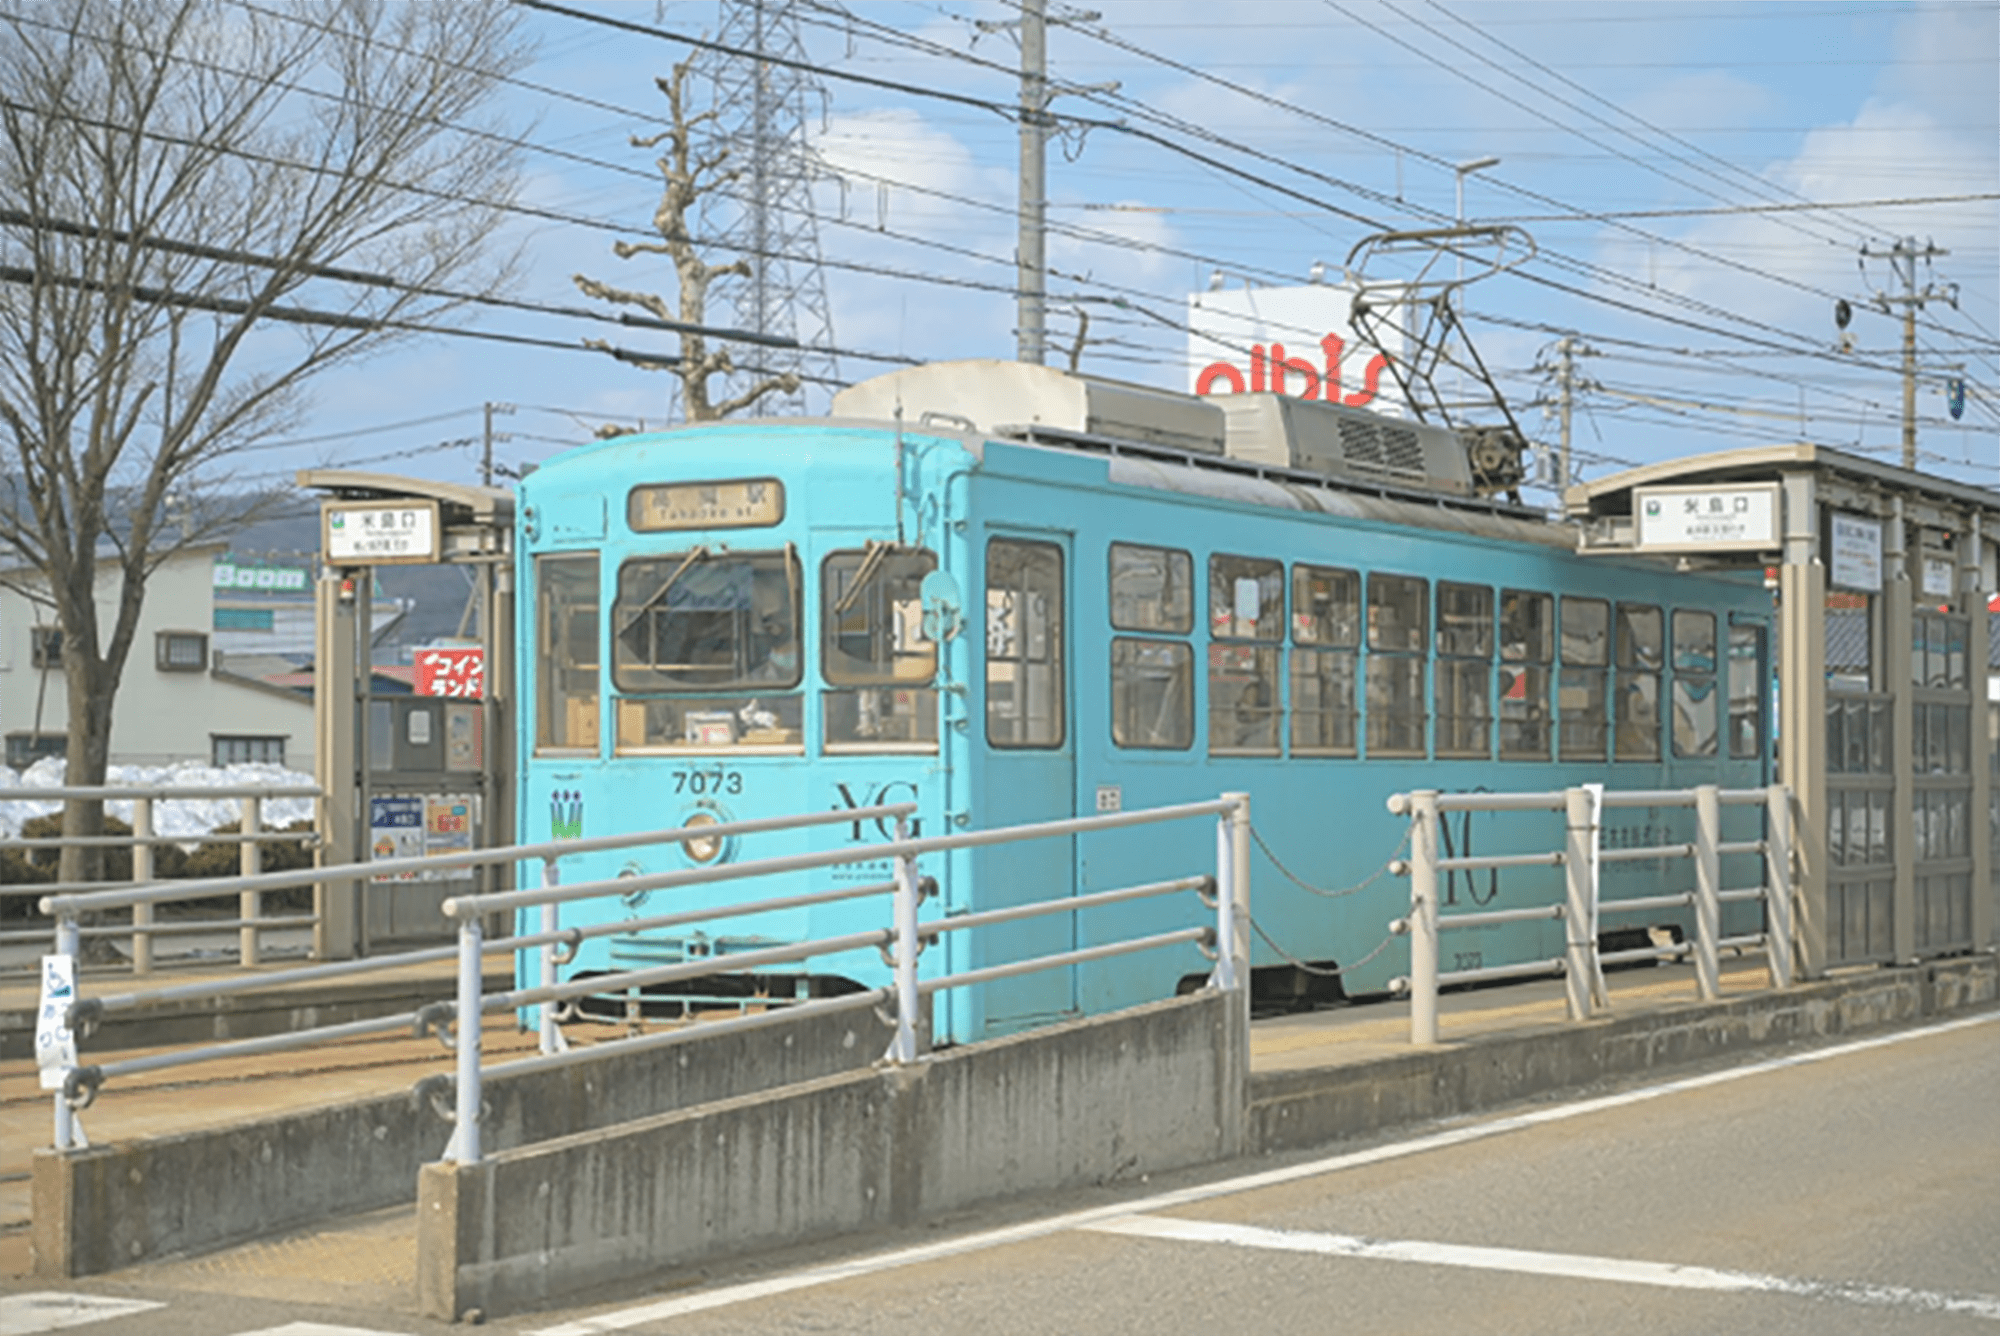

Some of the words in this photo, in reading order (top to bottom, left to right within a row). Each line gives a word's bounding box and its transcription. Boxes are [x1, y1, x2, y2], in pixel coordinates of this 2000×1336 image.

[212, 564, 304, 588] Boom
[671, 771, 743, 795] 7073
[830, 779, 927, 843] YG
